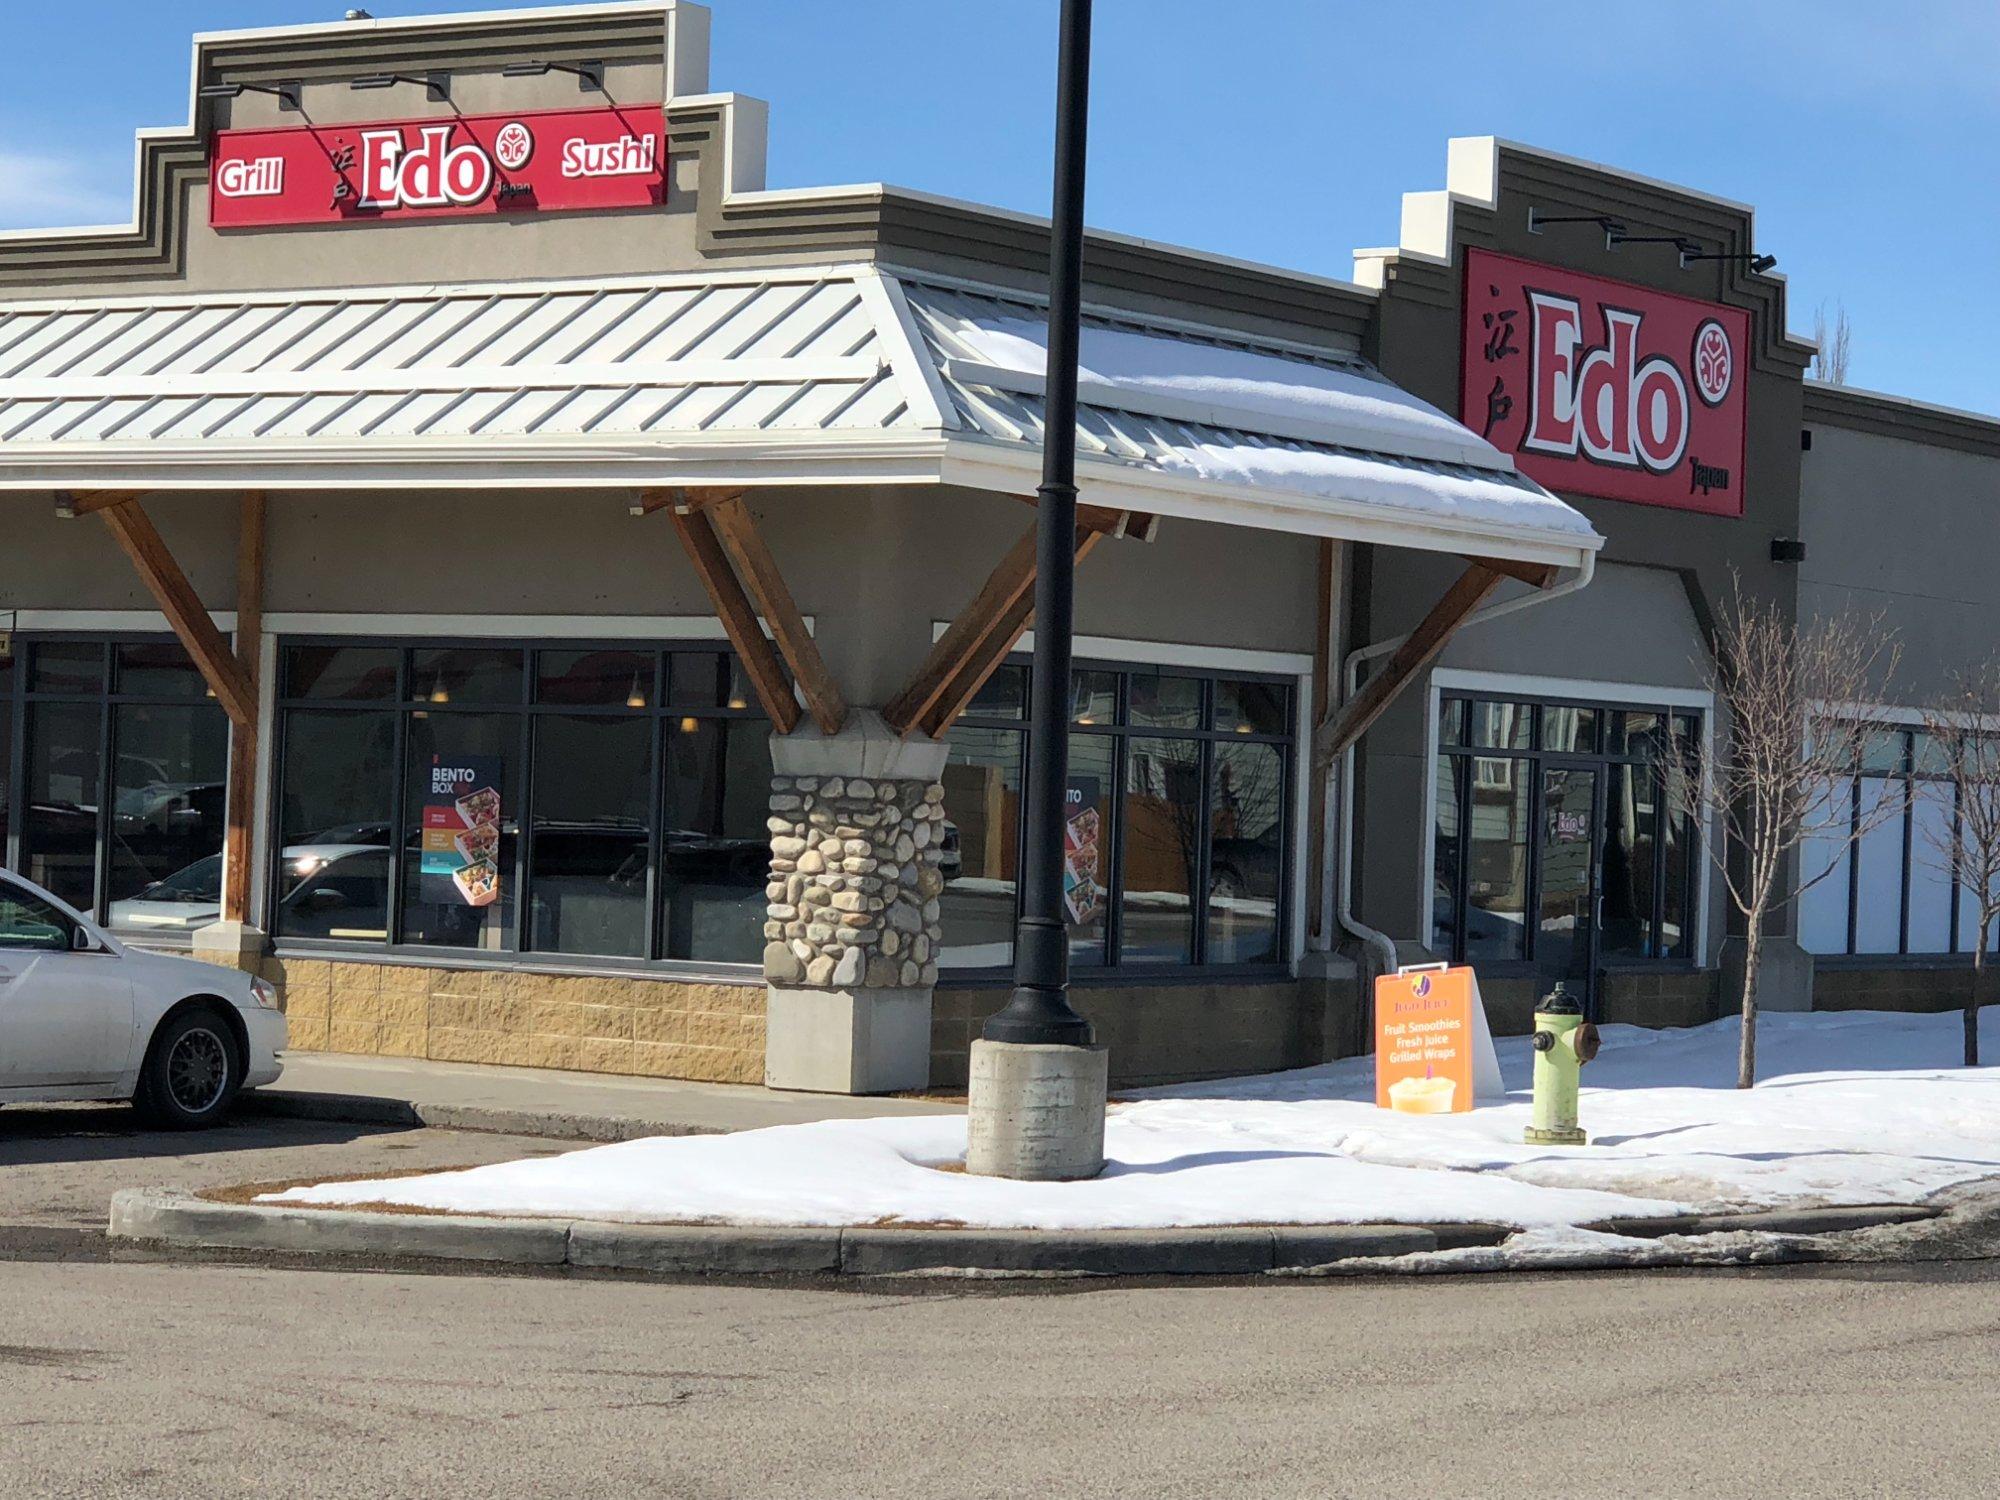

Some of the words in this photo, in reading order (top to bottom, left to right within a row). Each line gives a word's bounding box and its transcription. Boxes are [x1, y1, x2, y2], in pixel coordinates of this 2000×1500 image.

[357, 126, 493, 208] Edo
[562, 133, 656, 177] Sushi
[217, 157, 284, 198] Grill
[1519, 286, 1690, 473] Edo
[1690, 456, 1729, 495] Japan
[432, 768, 474, 782] BENTO
[432, 782, 453, 794] BOX
[1384, 1024, 1406, 1035] Fruit
[1408, 1019, 1461, 1034] Smoothies
[1389, 1050, 1422, 1064] Grilled
[1424, 1048, 1456, 1062] Wraps
[1397, 1037, 1422, 1048] Fresh
